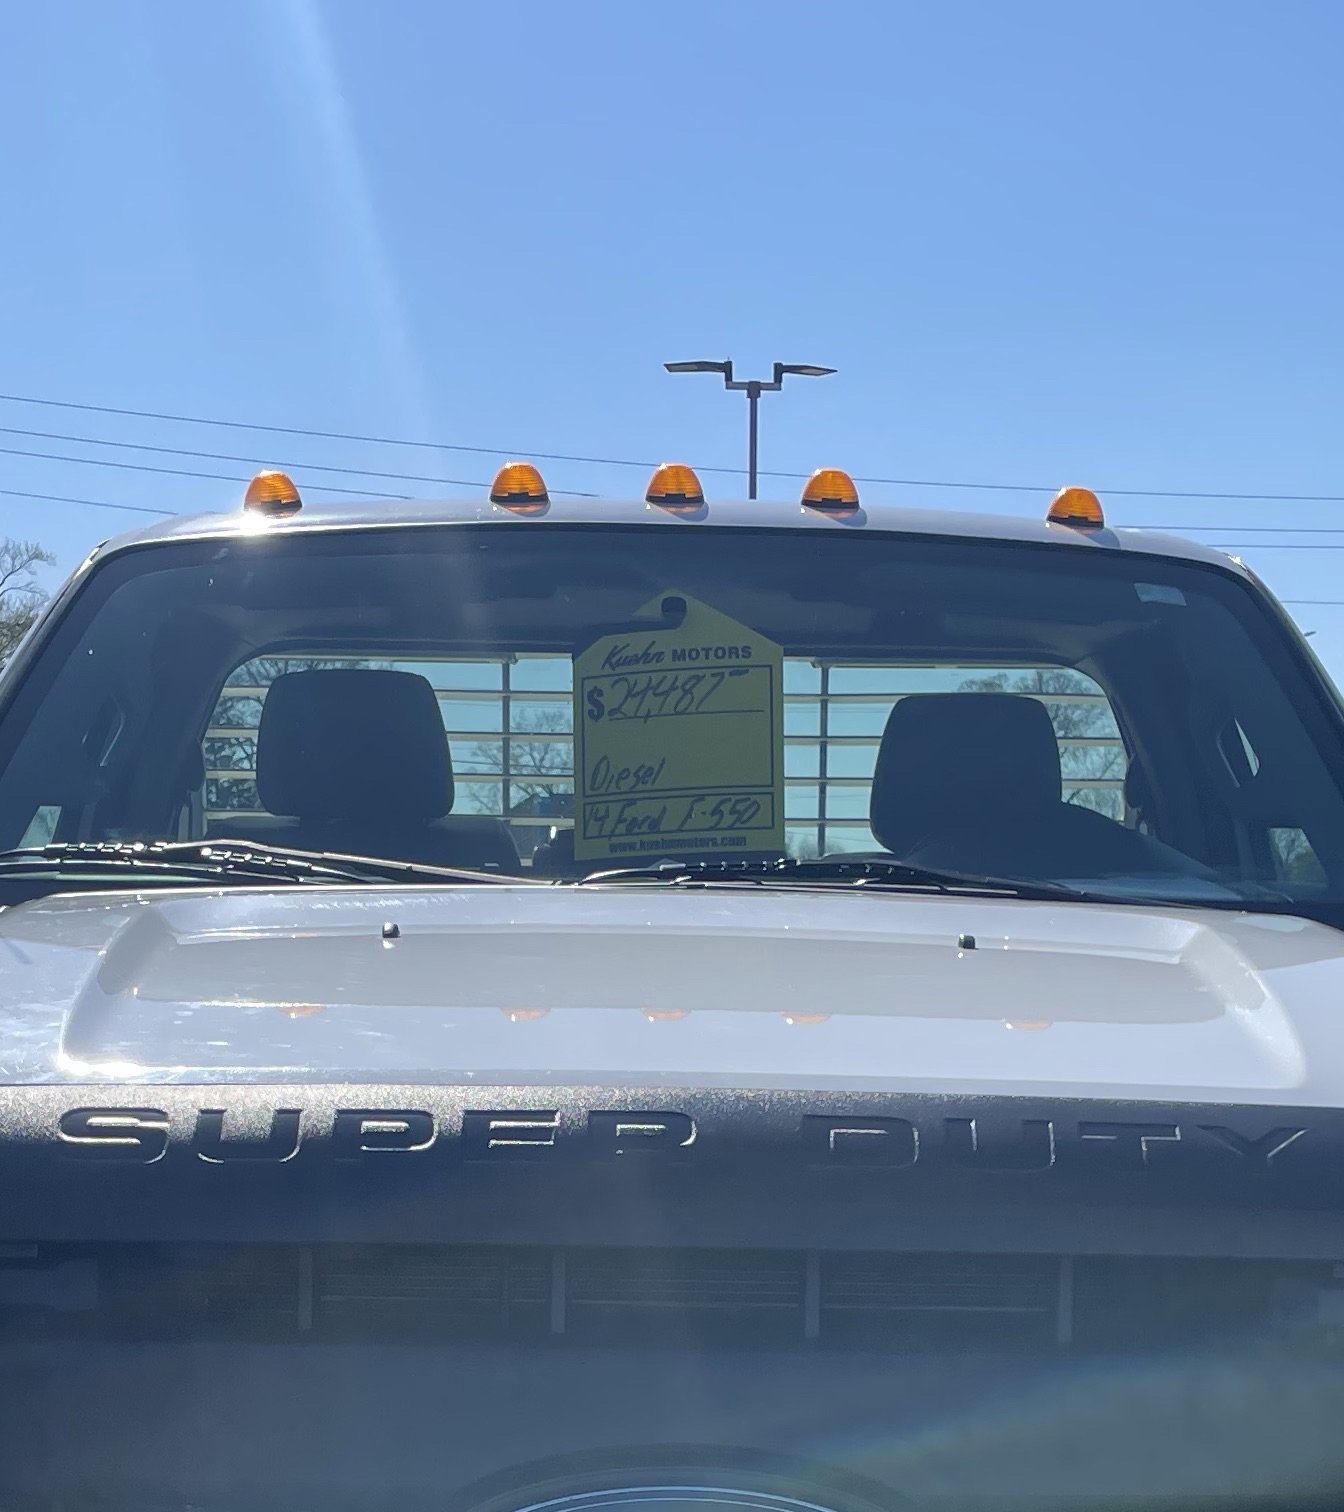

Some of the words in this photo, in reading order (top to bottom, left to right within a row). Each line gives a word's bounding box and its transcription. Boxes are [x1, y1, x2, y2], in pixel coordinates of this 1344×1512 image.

[601, 641, 664, 671] Kuehn
[672, 645, 753, 662] MOTORS
[590, 756, 666, 792] Diesel
[609, 800, 667, 840] Ford
[56, 1107, 698, 1164] SUPER
[801, 1114, 1311, 1172] DUTY
